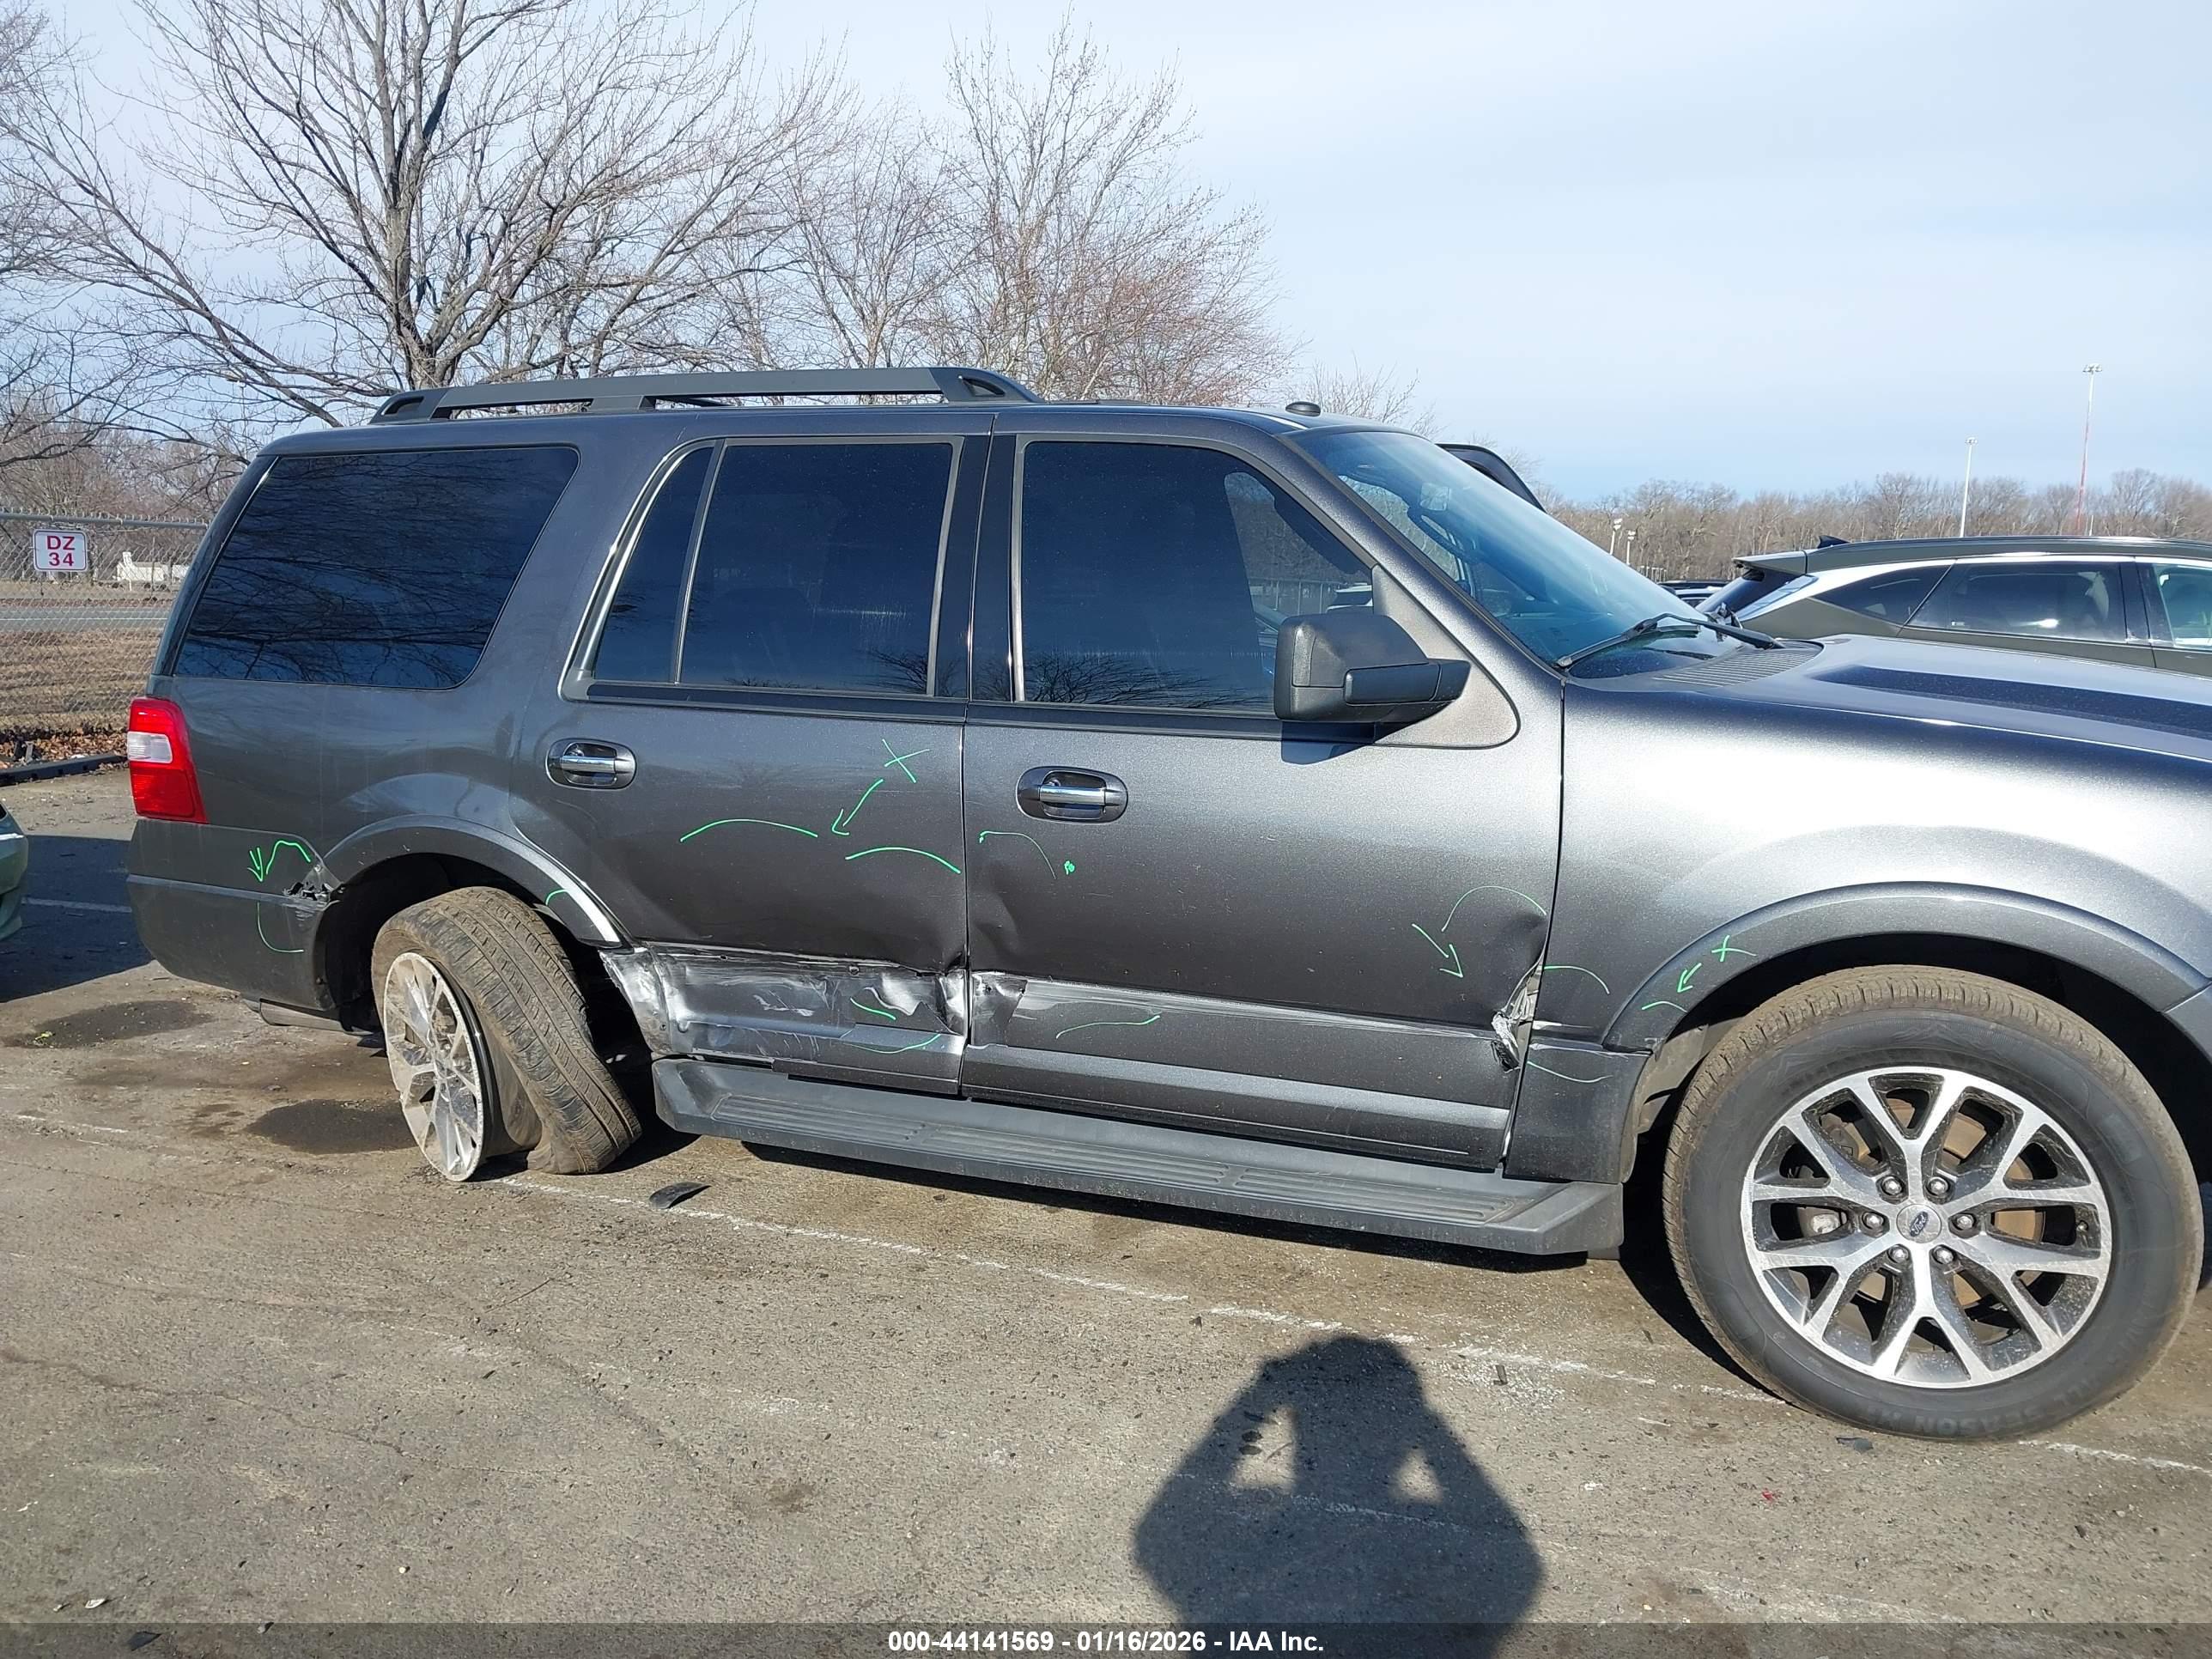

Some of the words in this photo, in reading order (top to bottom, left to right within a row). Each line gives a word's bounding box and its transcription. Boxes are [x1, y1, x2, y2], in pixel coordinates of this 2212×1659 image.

[46, 535, 76, 550] DZ
[48, 552, 75, 567] 34
[1911, 1213, 1928, 1236] Ford
